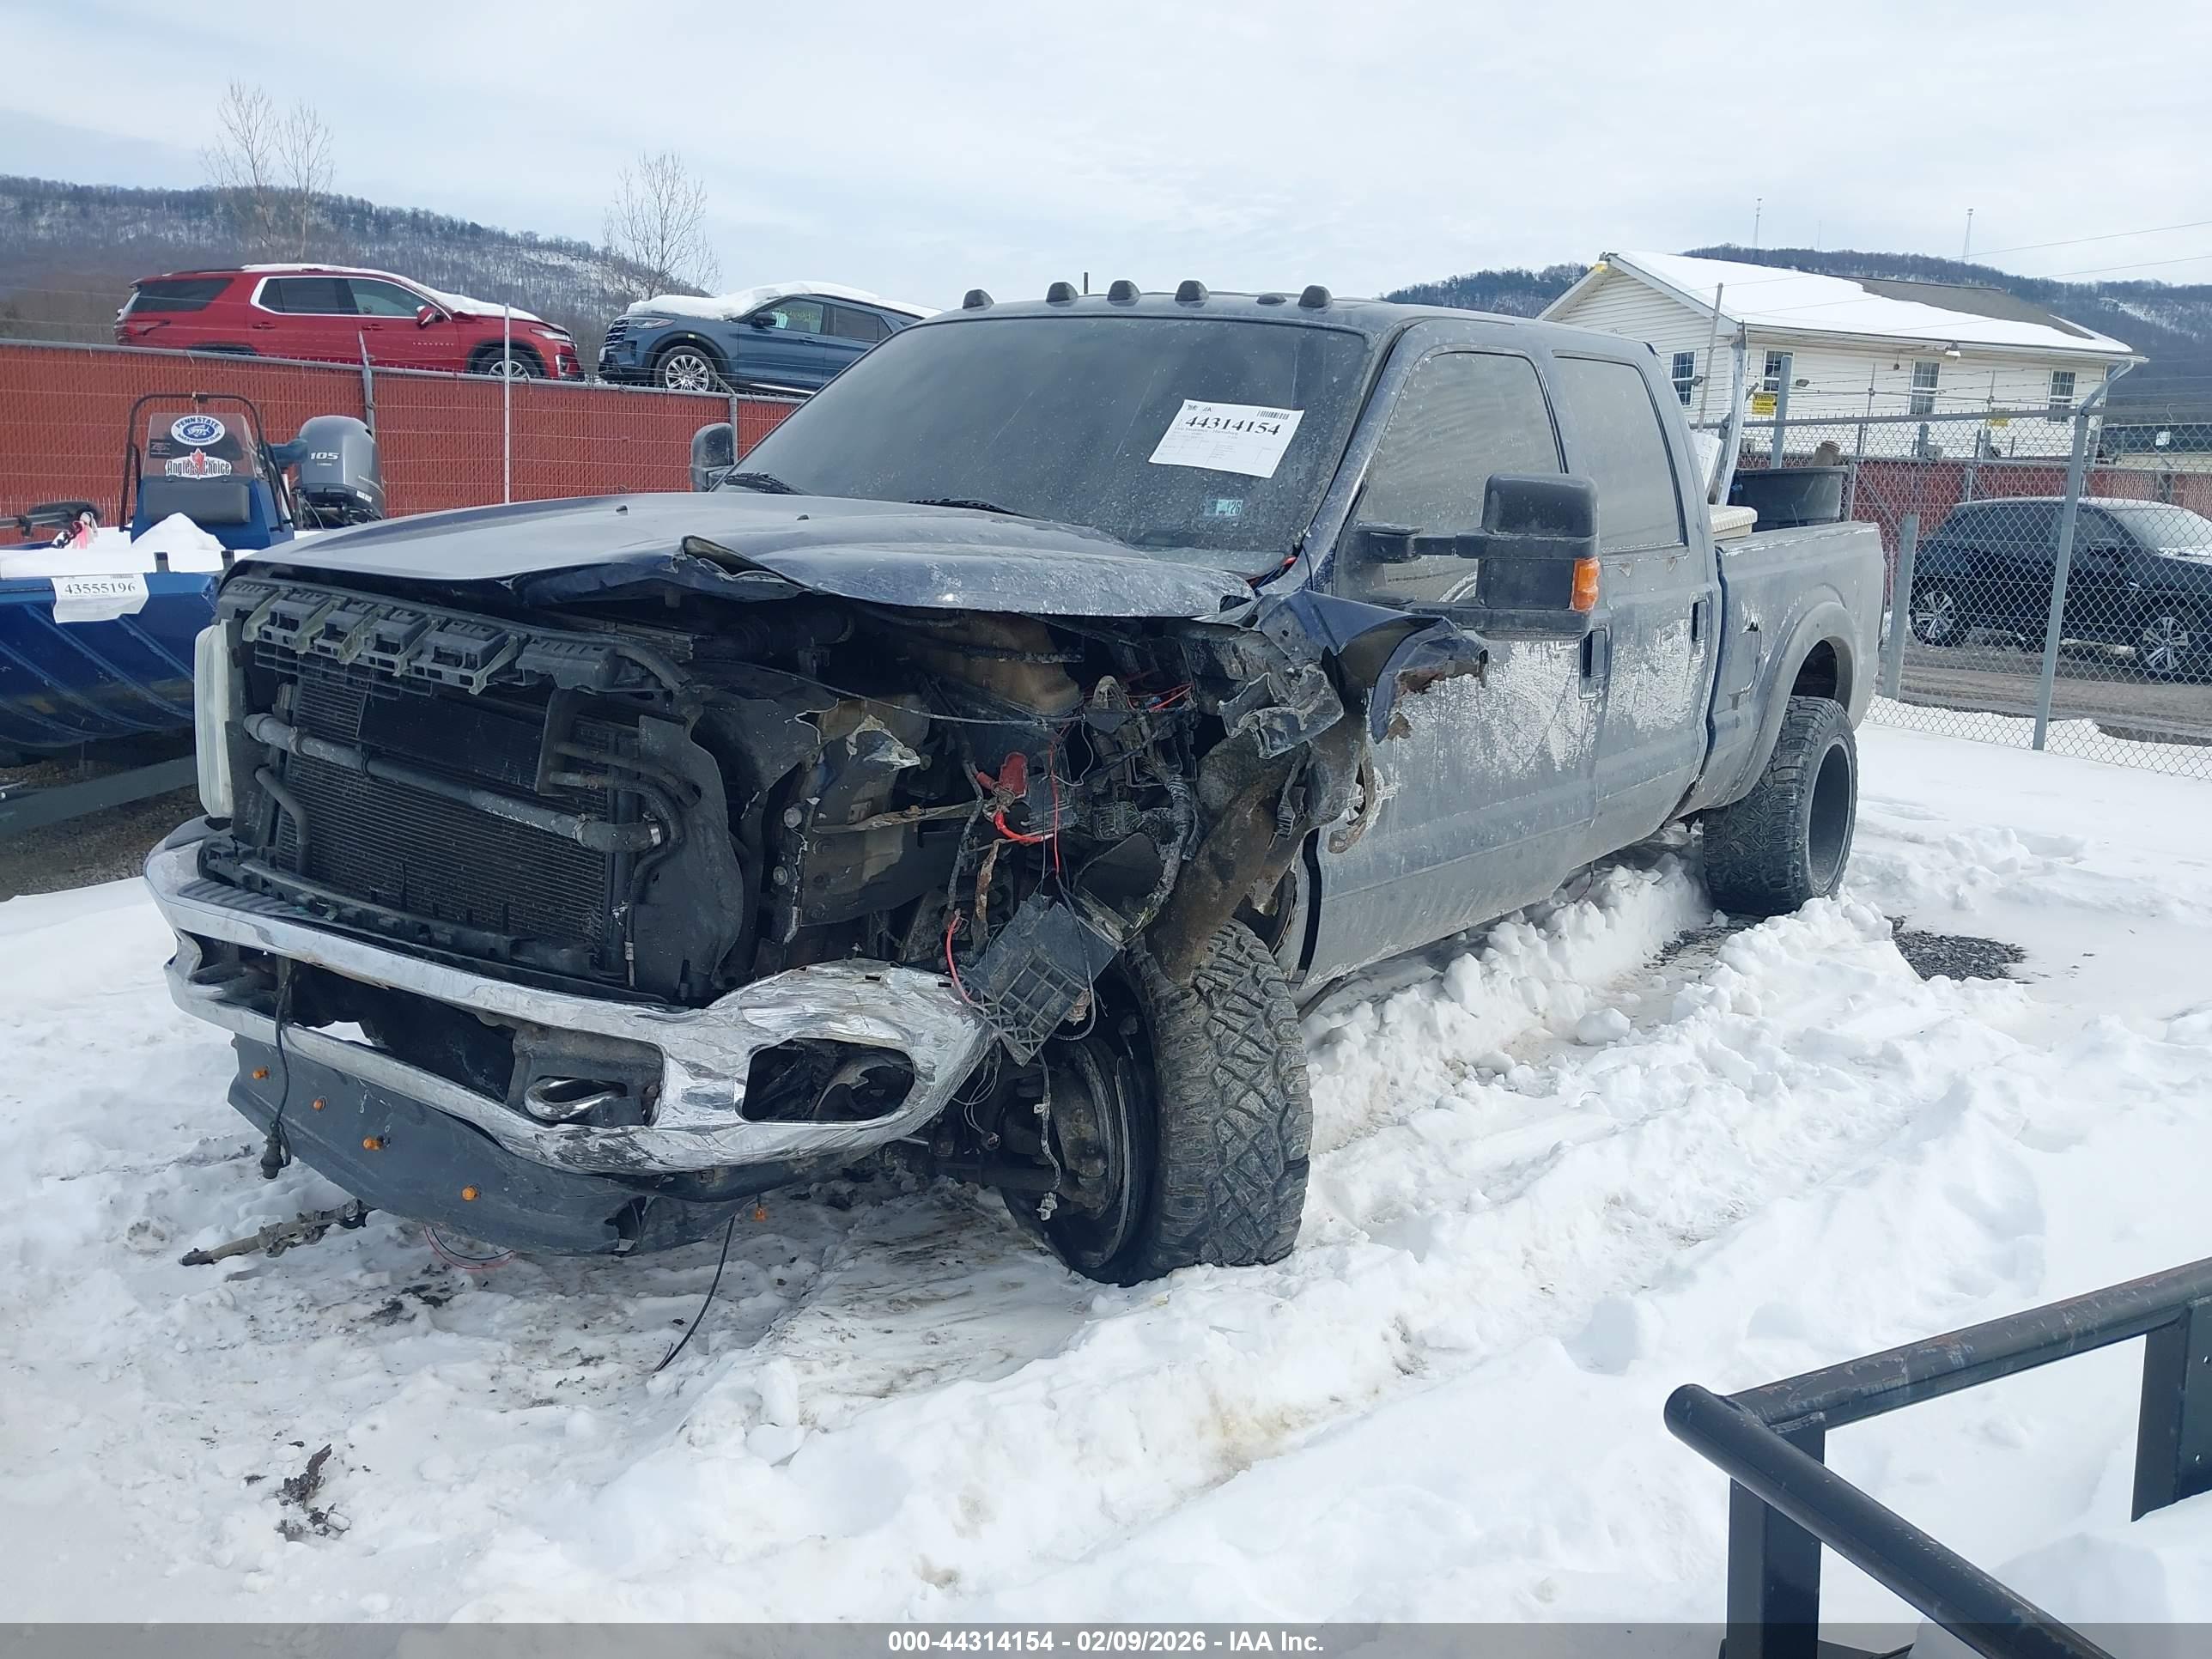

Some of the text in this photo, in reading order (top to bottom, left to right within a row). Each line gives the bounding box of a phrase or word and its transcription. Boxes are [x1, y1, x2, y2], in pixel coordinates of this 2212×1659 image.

[175, 416, 221, 428] PENN STATE
[1185, 416, 1281, 435] 44314154
[310, 452, 340, 460] 105
[203, 459, 230, 476] Choice
[64, 582, 136, 594] 43555196
